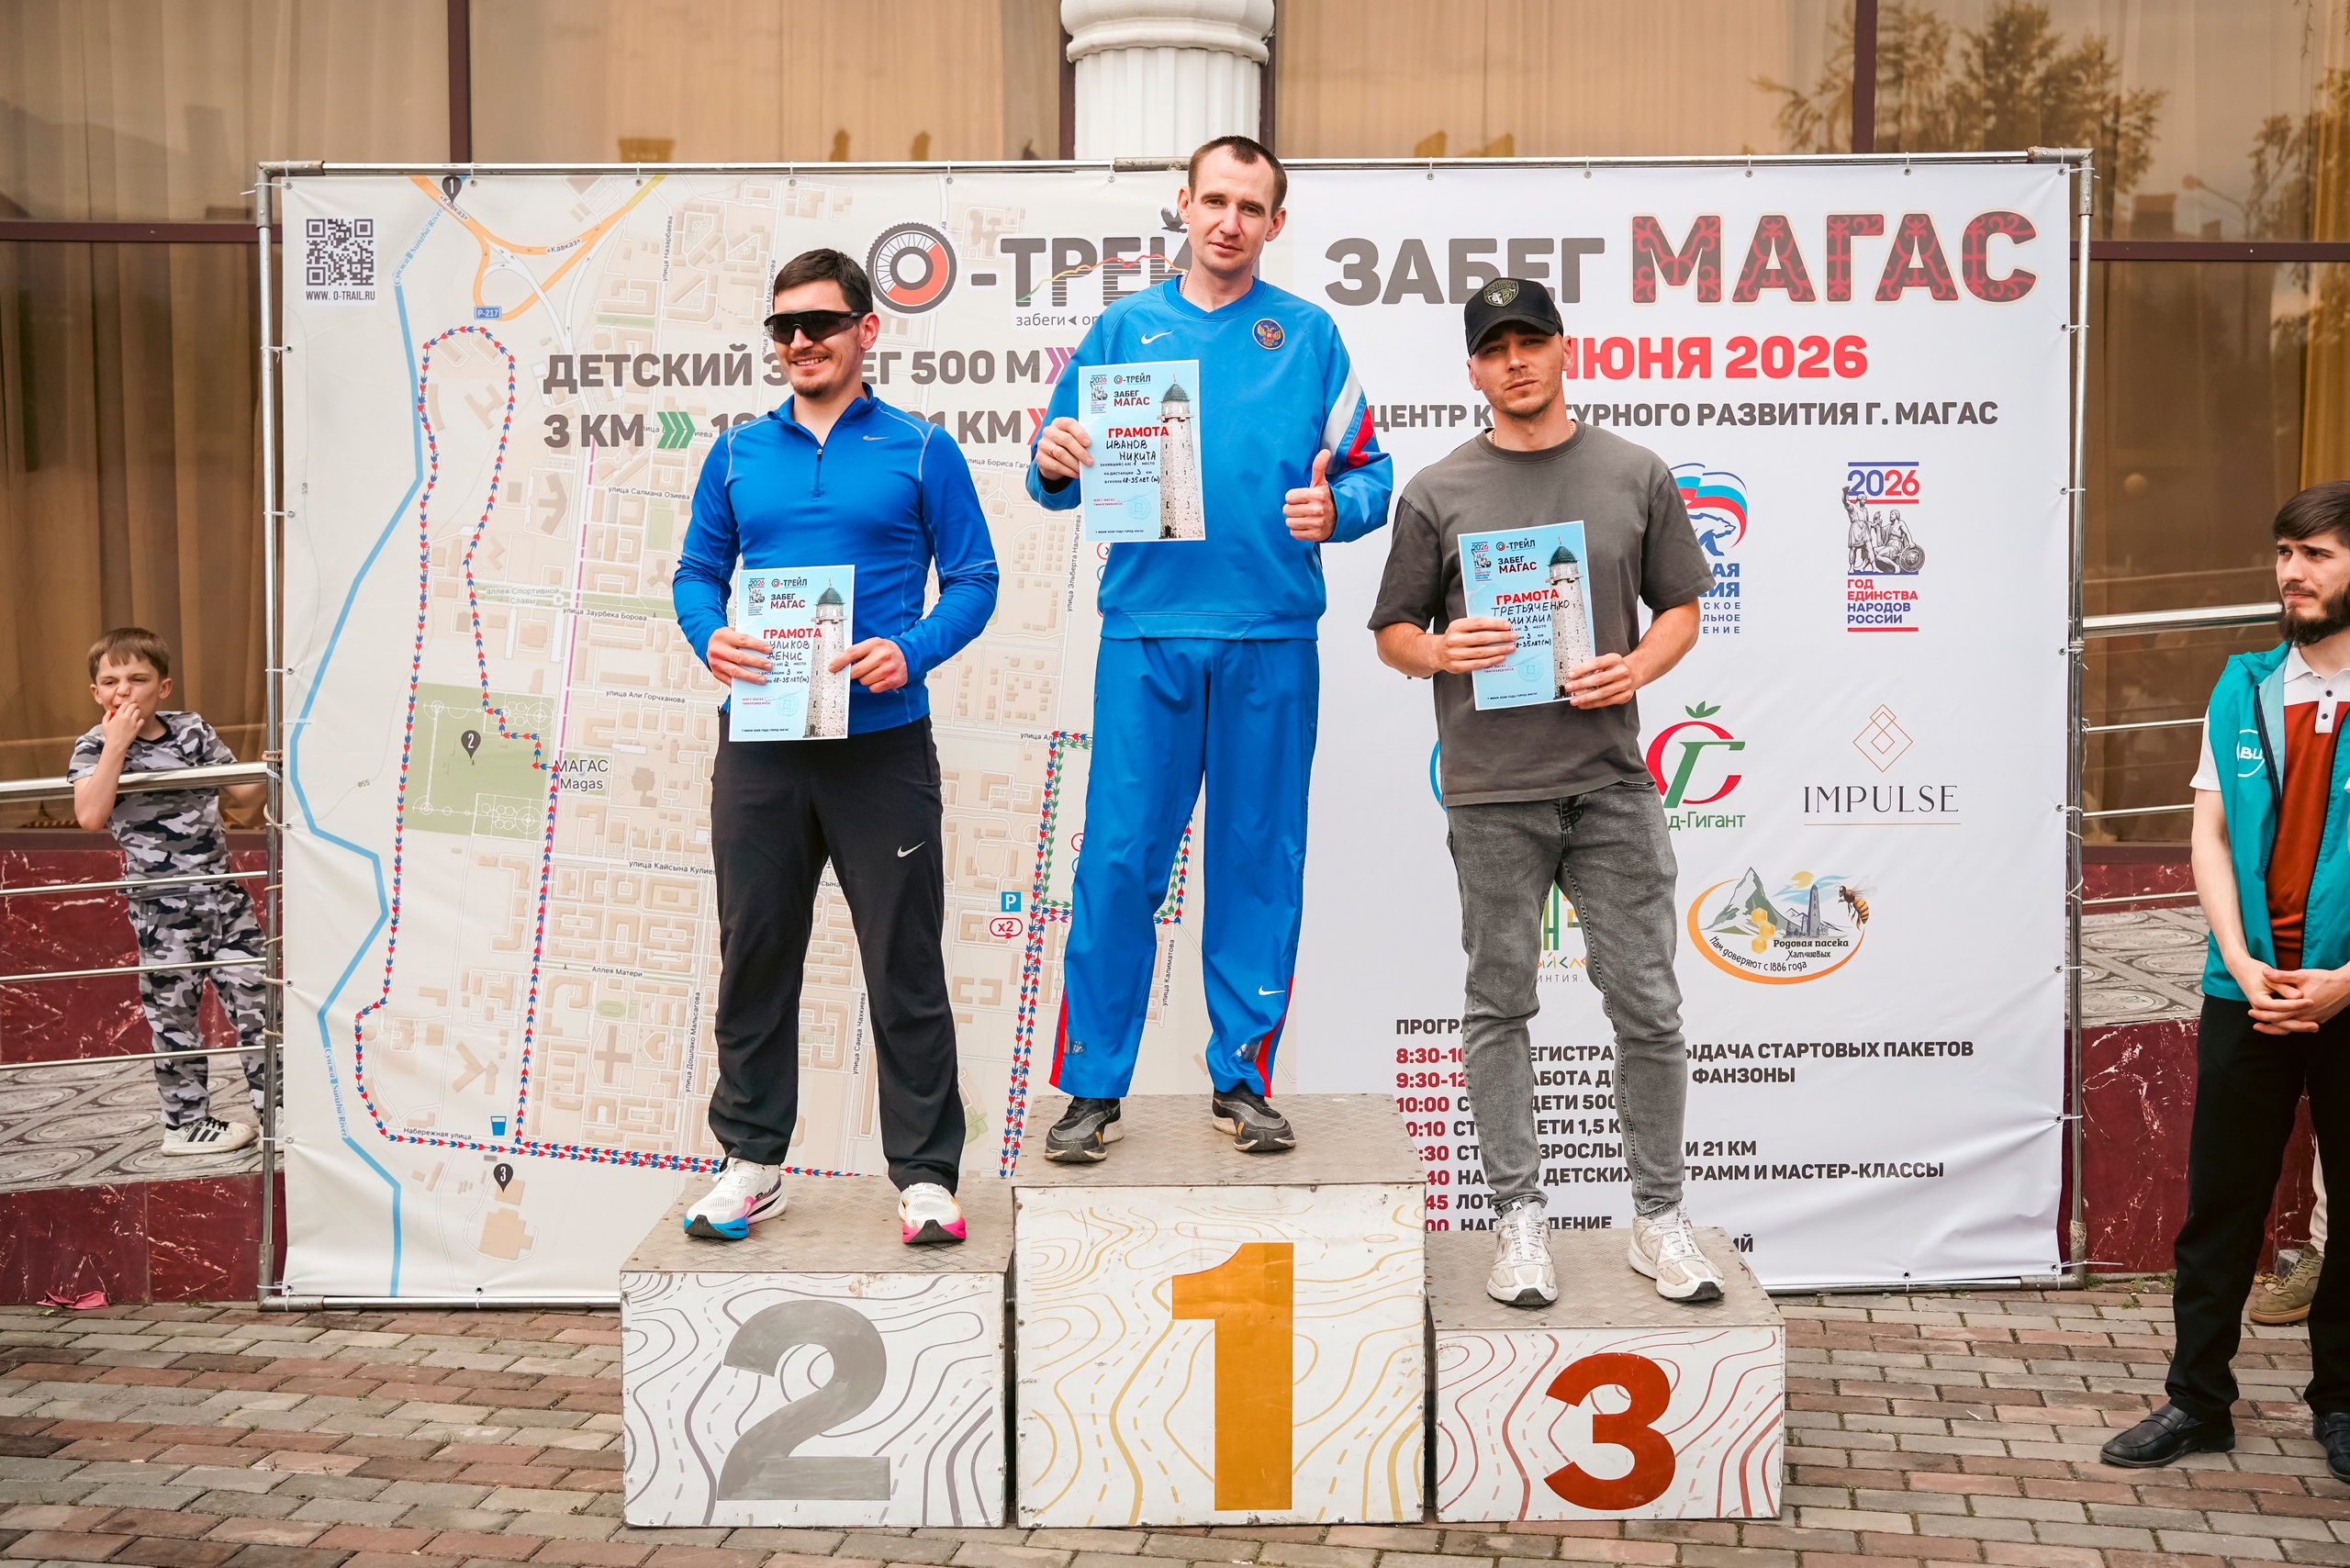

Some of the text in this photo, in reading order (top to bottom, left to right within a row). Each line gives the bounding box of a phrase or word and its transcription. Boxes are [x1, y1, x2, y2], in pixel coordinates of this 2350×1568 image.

[409, 207, 444, 254] Sunzha River
[663, 216, 673, 259] Назарбаева
[547, 239, 581, 253] «Кавказ»
[1631, 210, 2039, 306] МАГАС
[393, 258, 410, 286] Сунжа
[766, 259, 776, 303] Мальсагова
[306, 291, 330, 301] WWW.
[1016, 313, 1065, 327] забеги
[1726, 335, 1869, 381] 2026
[543, 343, 1041, 394] ДЕТСКИЙ ЗЕГ 500 М
[1113, 390, 1140, 398] ЗАБЕГ
[1113, 396, 1150, 407] МАГАС
[1369, 404, 1469, 432] ЦЕНТР
[1697, 403, 1862, 426] РАЗВИТИЯ
[1866, 403, 1889, 426] Г.
[1896, 401, 1998, 426] МАГАС
[543, 414, 570, 448] 3
[581, 414, 644, 448] КМ
[958, 410, 1021, 444] КМ
[1108, 426, 1169, 438] ГРАМОТА
[1106, 439, 1148, 450] ИВАНОВ
[987, 459, 1013, 468] Бориса
[1119, 451, 1157, 461] НИКИТА
[1847, 469, 1920, 496] 2026
[608, 486, 690, 500] улица Салмана Озиева
[1072, 515, 1081, 553] Нальгиева
[1498, 555, 1525, 565] ЗАБЕГ
[1499, 561, 1538, 574] МАГАС
[1068, 554, 1077, 588] Эльберта
[511, 588, 560, 596] Спортивной
[1847, 579, 1874, 590] ГОД
[1496, 588, 1559, 605] ГРАМОТА
[1847, 590, 1919, 602] ЕДИНСТВА
[770, 599, 806, 609] МАГАС
[1847, 602, 1911, 614] НАРОДОВ
[563, 607, 647, 622] улица Заурбека Борова
[1507, 614, 1552, 625] МИХАИЛ
[1847, 614, 1902, 624] РОССИИ
[763, 627, 822, 639] ГРАМОТА
[769, 640, 810, 650] УЛИКОВ
[767, 651, 803, 661] ДЕНИС
[605, 690, 627, 699] улица
[644, 693, 686, 704] Горчханова
[468, 733, 474, 749] 2
[554, 760, 609, 773] МАГАС
[560, 778, 604, 792] Magas
[1803, 785, 1959, 813] IMPULSE
[628, 860, 652, 869] улица
[654, 861, 688, 873] Кайсына
[1773, 939, 1849, 950] Родовая пасека
[1709, 935, 1723, 952] Нам
[1723, 948, 1762, 970] доверяют
[1770, 962, 1787, 972] 1886
[1789, 961, 1807, 973] года
[1786, 950, 1831, 961] Хамчиевых
[592, 966, 643, 978] Аллея Матери
[1161, 939, 1175, 1006] улица Калиматова
[691, 992, 701, 1035] Мальсагова
[857, 992, 867, 1027] Чахкиева
[1396, 1019, 1461, 1035] ПРОГР
[854, 1028, 863, 1051] Саида
[1685, 1043, 1754, 1062] ЫДАЧА
[1757, 1042, 1880, 1059] СТАРТОВЫХ
[1884, 1041, 1974, 1058] ПАКЕТОВ
[325, 1048, 336, 1079] Сунжа
[1692, 1067, 1796, 1084] ФАНЗОНЫ
[332, 1084, 348, 1138] Sunzha River
[1397, 1096, 1449, 1113] 10:00
[403, 1127, 449, 1138] Набережная
[1406, 1121, 1446, 1138] 0:10
[1537, 1119, 1574, 1135] ЕТИ
[1578, 1119, 1605, 1137] 1,5
[1686, 1142, 1699, 1157] И
[1703, 1141, 1723, 1157] 21
[1728, 1140, 1757, 1156] КМ
[500, 1167, 507, 1182] 3
[1754, 1165, 1767, 1180] И
[1771, 1162, 1944, 1180] МАСТЕР-КЛАССЫ
[1172, 1241, 1293, 1511] 1
[716, 1299, 890, 1501] 2
[1543, 1351, 1675, 1509] 3
